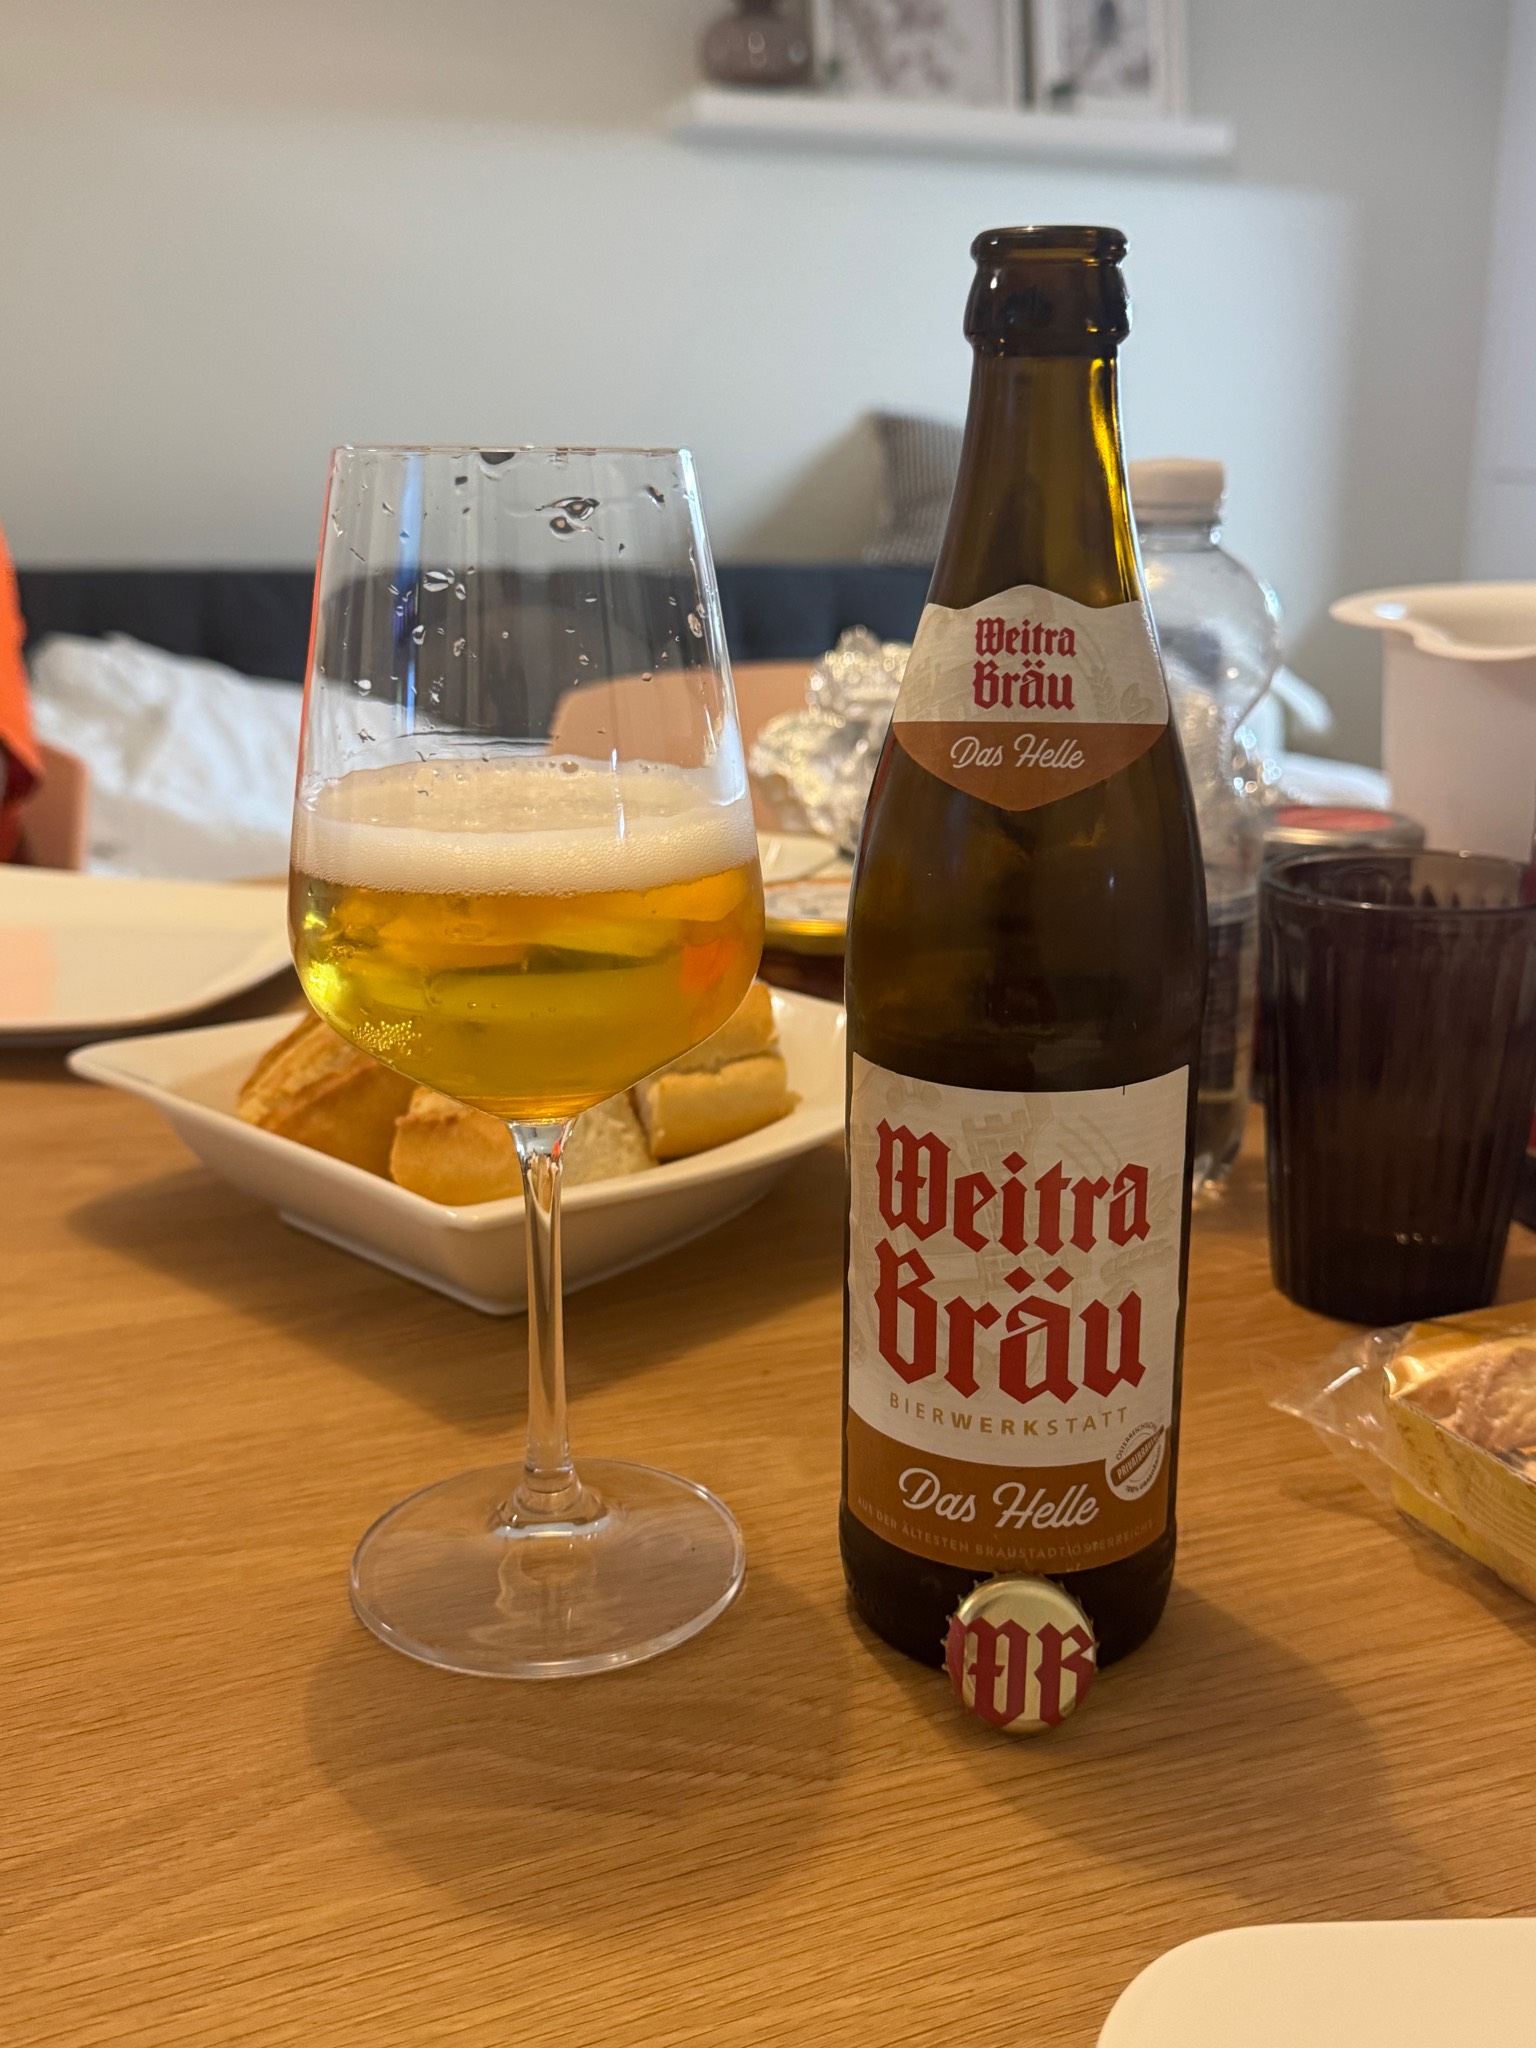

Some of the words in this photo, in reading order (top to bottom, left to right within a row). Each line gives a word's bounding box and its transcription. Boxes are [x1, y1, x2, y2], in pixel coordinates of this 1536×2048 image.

[975, 617, 1077, 657] Weitra
[972, 659, 1076, 711] Bräu
[950, 736, 1004, 769] Das
[1012, 733, 1086, 770] Helle
[875, 1117, 1151, 1256] Weitra
[873, 1237, 1147, 1404] Bräu
[889, 1392, 1128, 1436] BIERWERKSTATT
[857, 1497, 873, 1517] AUS
[876, 1509, 897, 1530] DER
[901, 1519, 970, 1553] ÄLTESTEN
[898, 1467, 977, 1522] Das
[992, 1481, 1100, 1529] Helle
